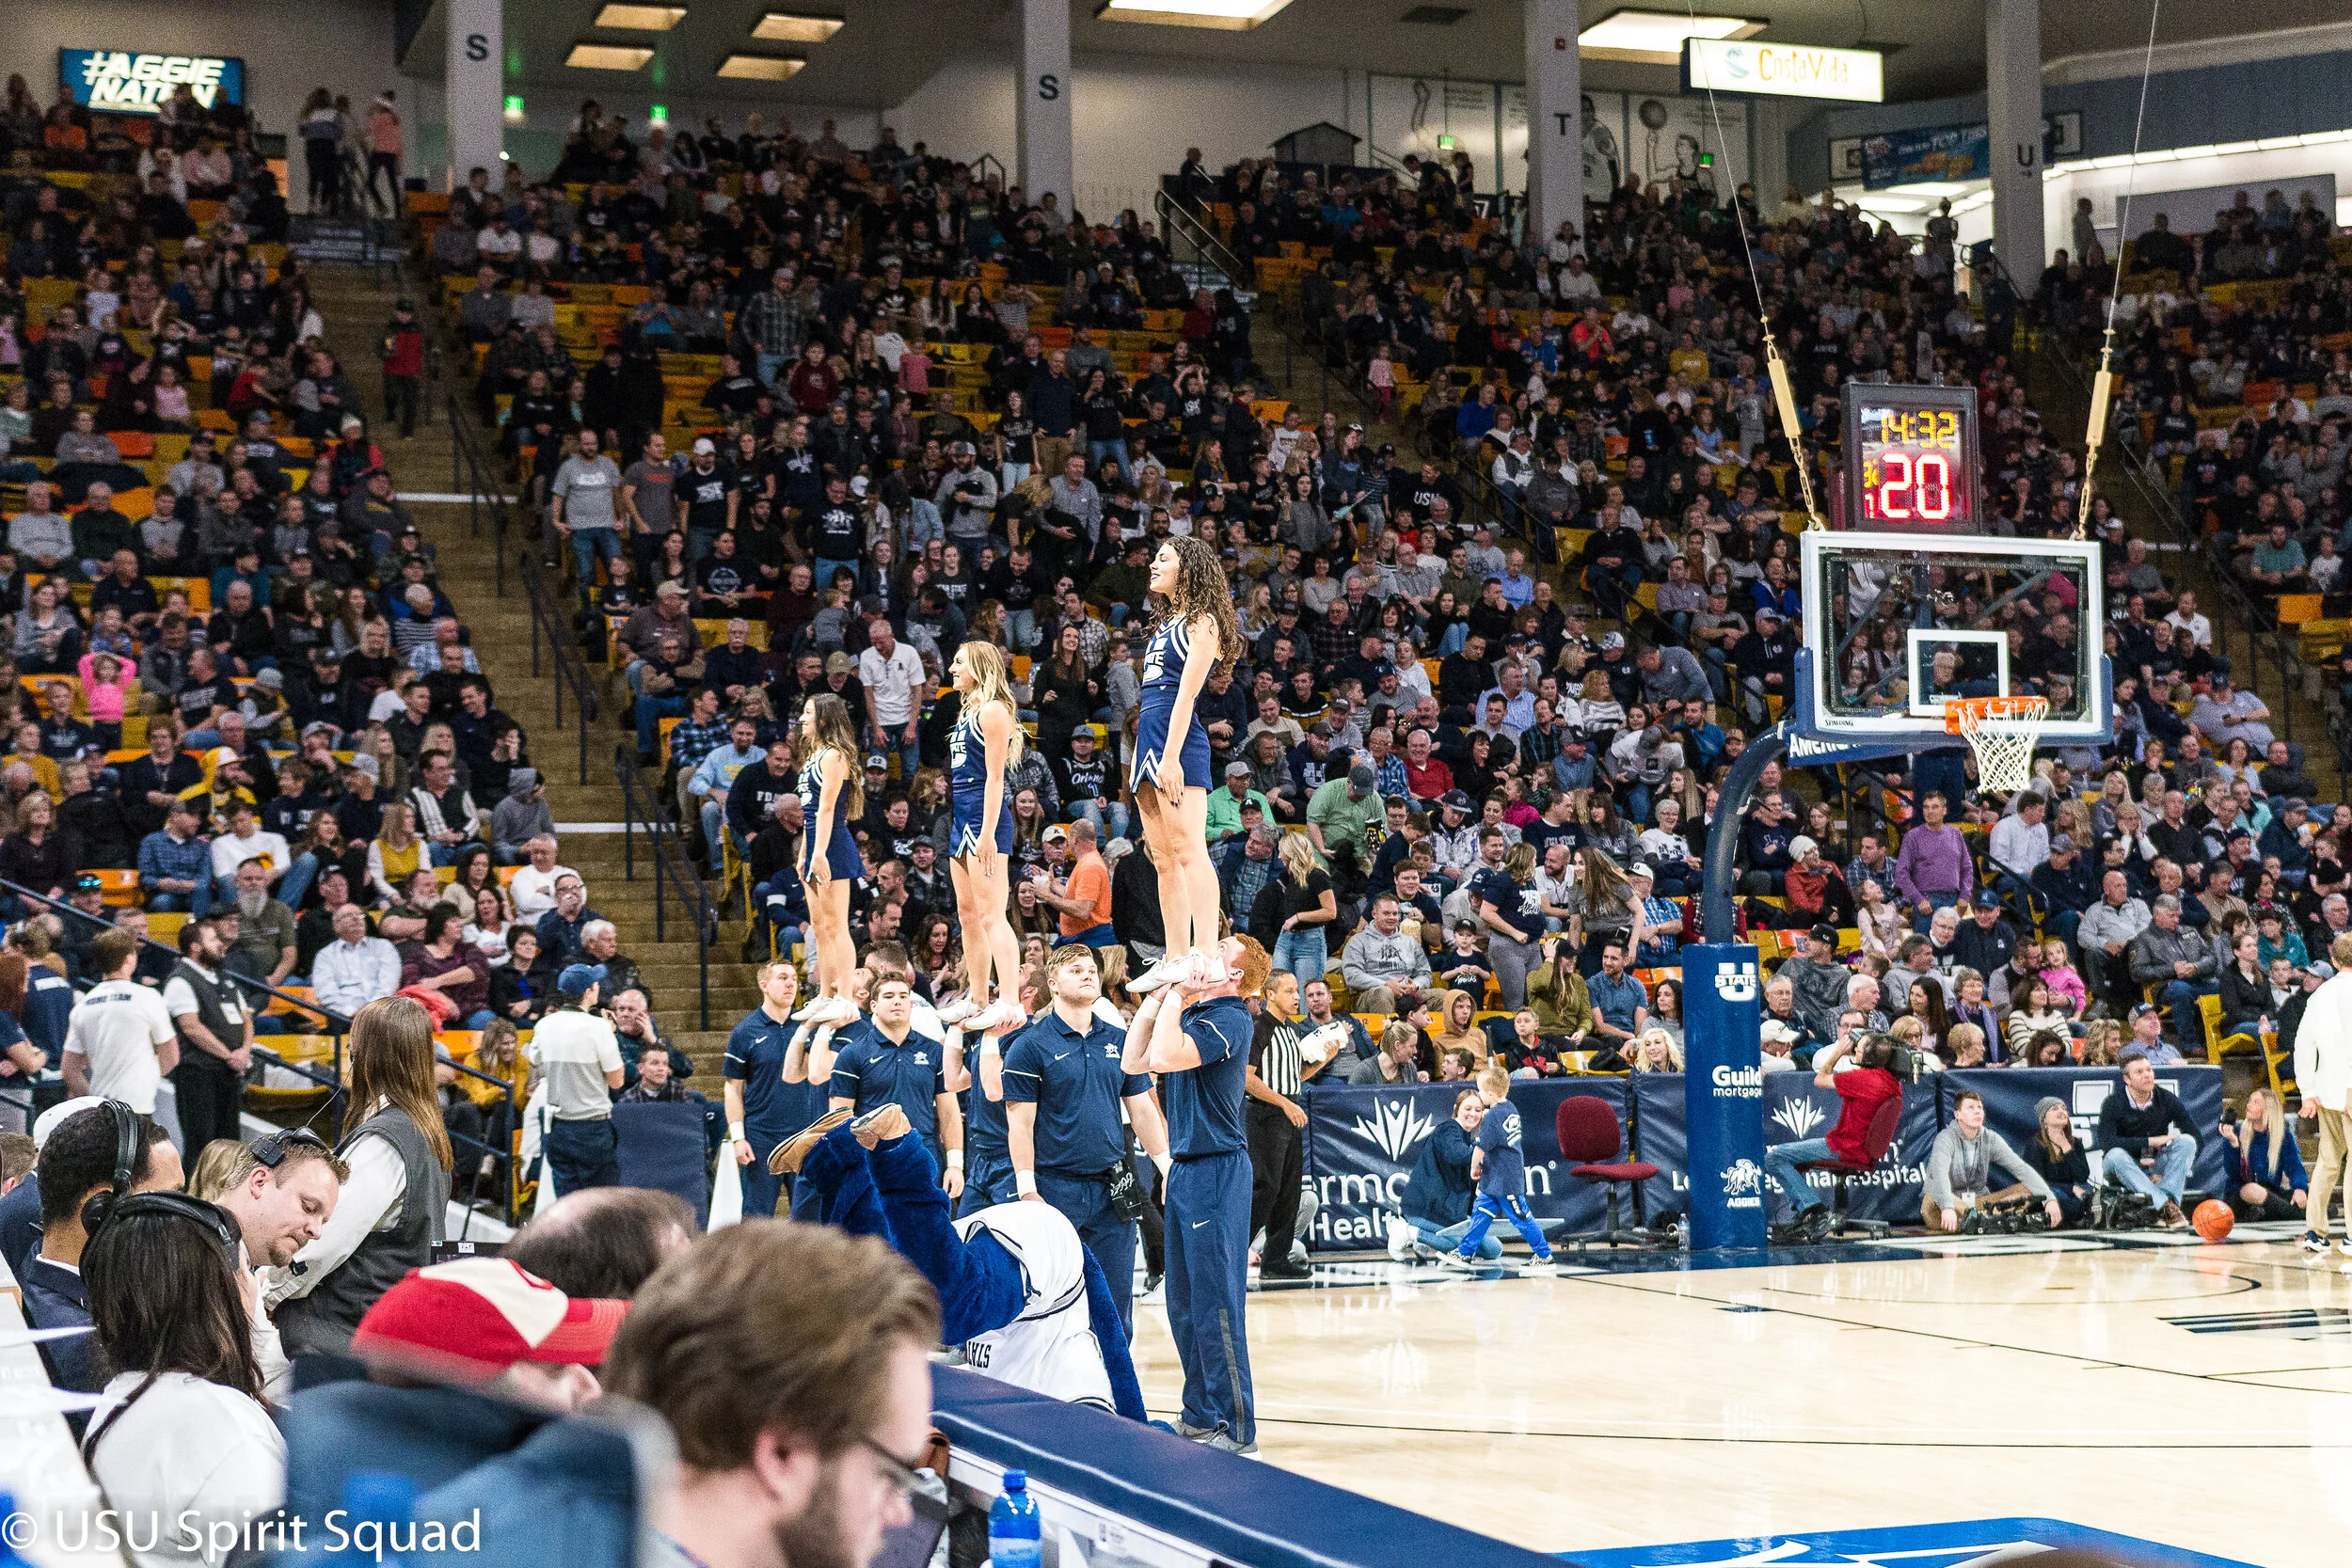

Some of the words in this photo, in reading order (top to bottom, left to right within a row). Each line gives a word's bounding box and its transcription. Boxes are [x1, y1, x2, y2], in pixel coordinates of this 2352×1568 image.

[467, 33, 488, 60] S
[82, 51, 226, 87] #AGGIE
[89, 77, 218, 109] NATIN
[1039, 74, 1058, 101] S
[1554, 113, 1571, 136] T
[2017, 144, 2034, 167] U
[1881, 410, 1956, 449] 14:32
[1880, 453, 1948, 519] 20
[1825, 719, 1854, 727] SPALDING
[1714, 974, 1756, 988] STATE
[1711, 1065, 1762, 1086] Guild
[1309, 1207, 1403, 1242] Healt
